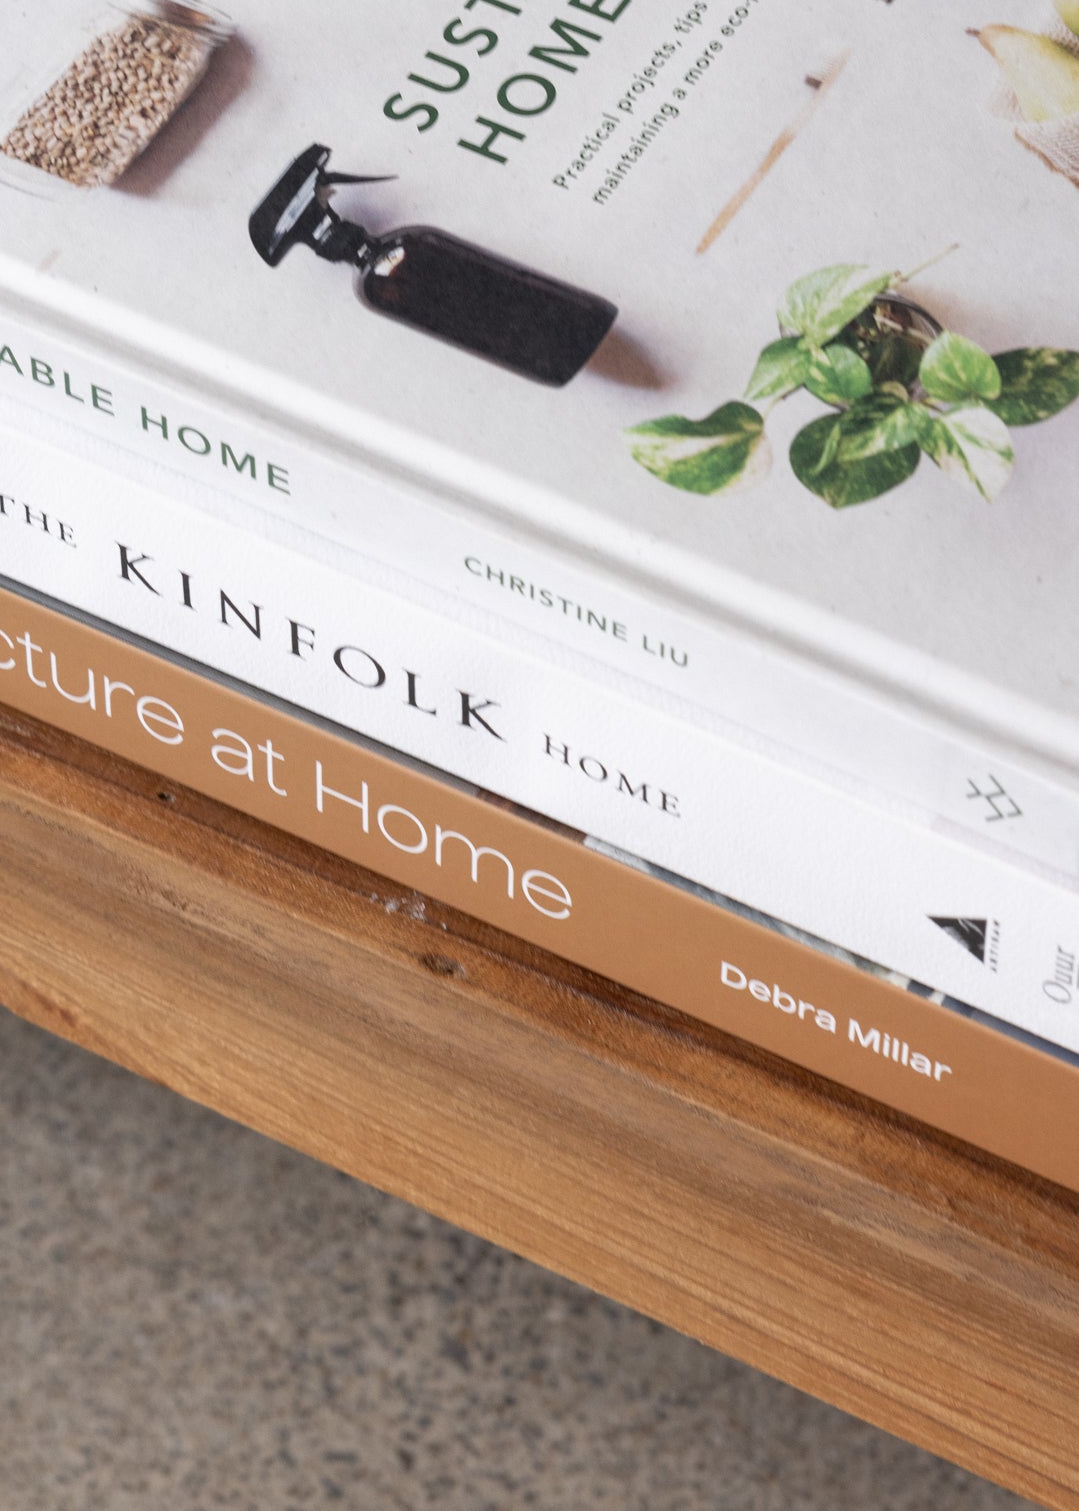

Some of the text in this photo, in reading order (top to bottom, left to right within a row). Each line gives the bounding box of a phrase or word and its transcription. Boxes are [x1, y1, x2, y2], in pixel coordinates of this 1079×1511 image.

[552, 112, 621, 190] Practical
[617, 39, 683, 115] projects,
[674, 0, 708, 34] tips
[592, 102, 680, 205] maintaining
[672, 87, 688, 101] a
[684, 39, 724, 86] more
[139, 404, 292, 496] HOME
[115, 540, 508, 745] KINFOLK
[541, 734, 682, 820] HOME
[464, 555, 690, 668] CHRISTINE LIU
[211, 727, 288, 798] at
[315, 760, 574, 921] Home
[719, 960, 954, 1083] Debra Millar
